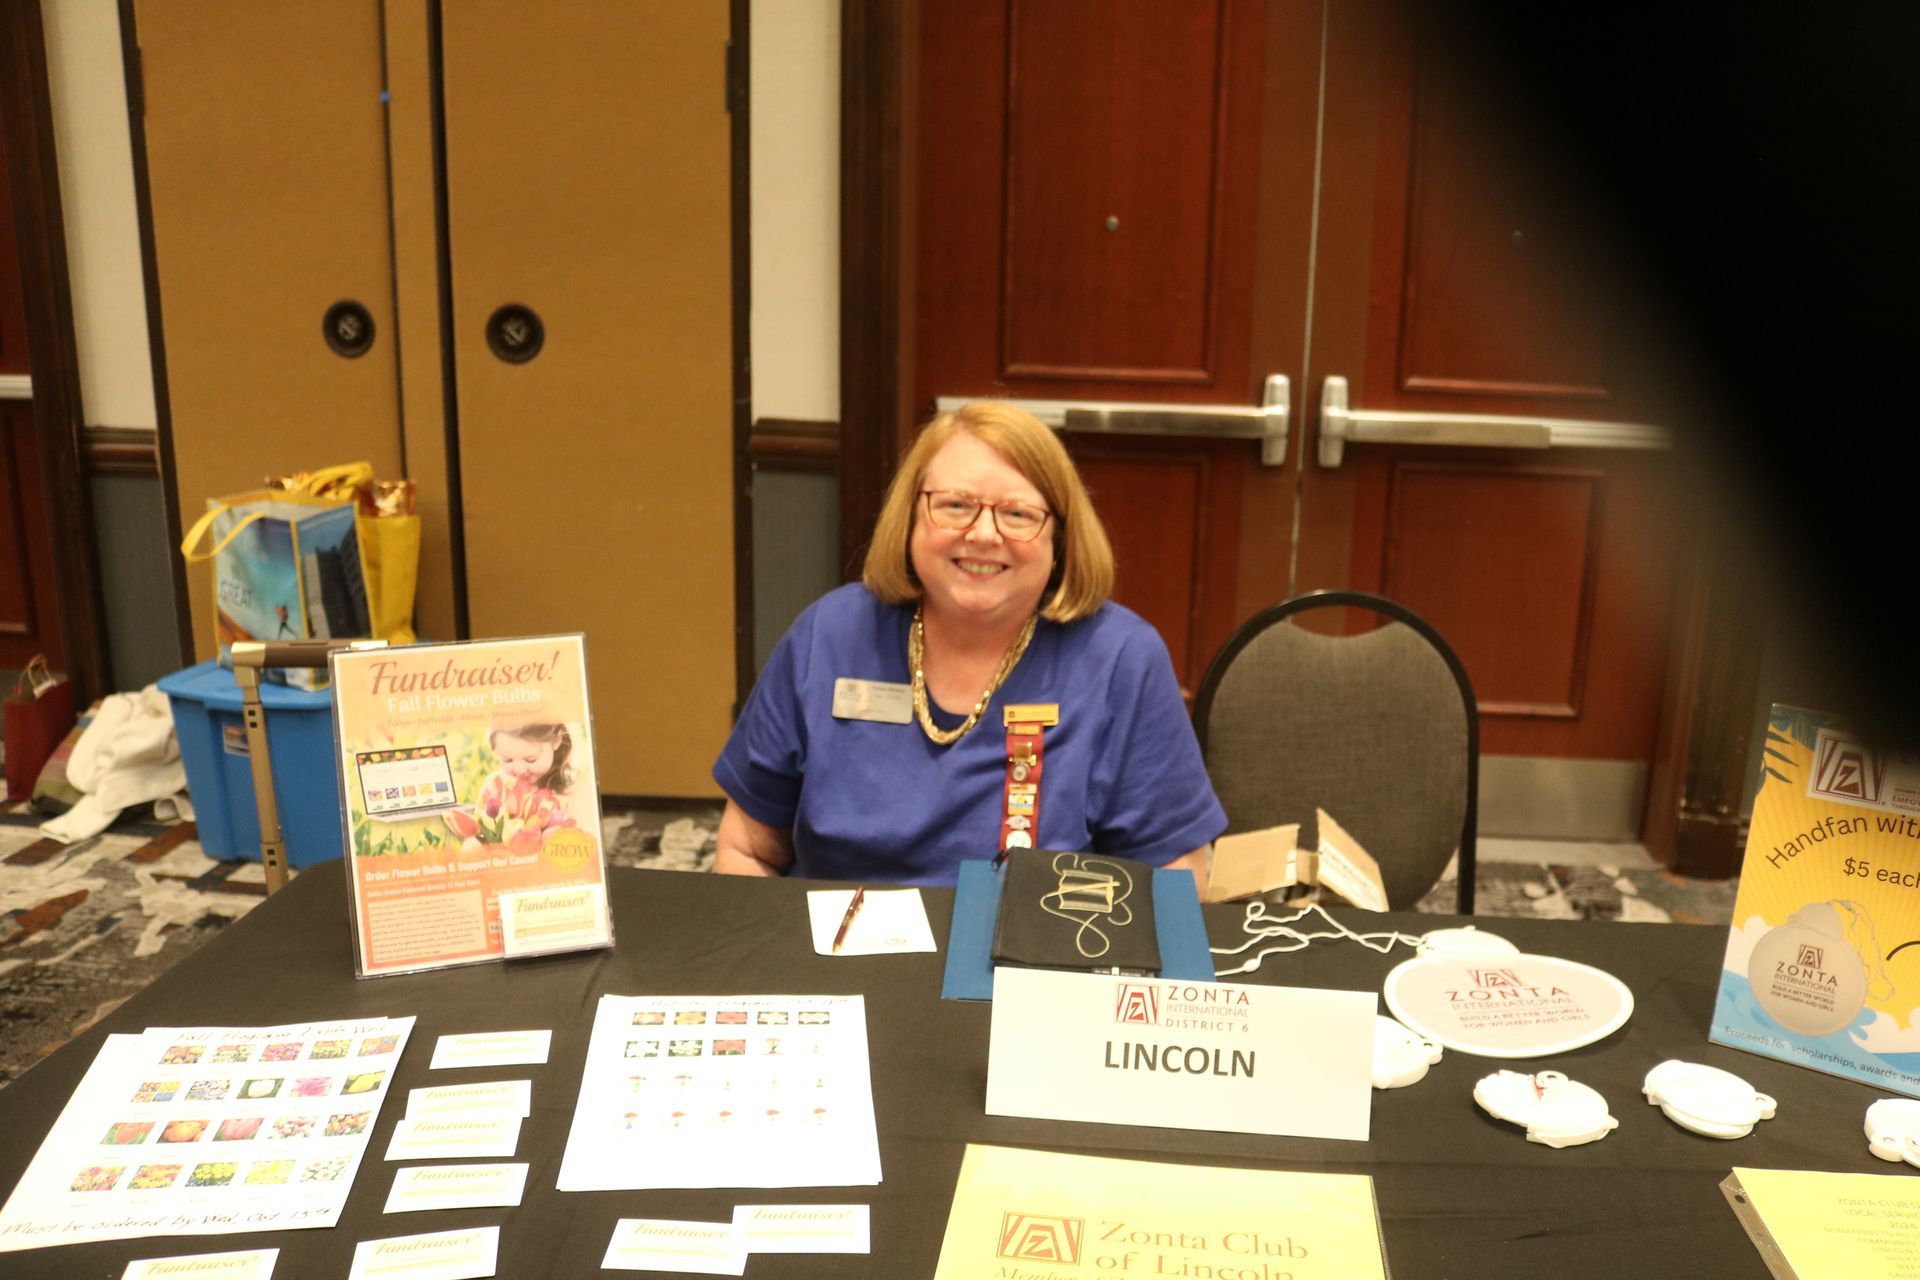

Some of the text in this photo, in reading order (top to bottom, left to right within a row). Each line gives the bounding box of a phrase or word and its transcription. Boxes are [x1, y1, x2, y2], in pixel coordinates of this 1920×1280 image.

[368, 650, 560, 696] Fundraiser!
[387, 686, 543, 714] Fall Flower Bulbs
[542, 843, 594, 859] GROW
[1765, 815, 1920, 869] Handfan wit
[365, 871, 389, 882] Order
[392, 868, 420, 879] Flower
[422, 865, 446, 876] Bulbs
[457, 858, 492, 873] Support
[1843, 857, 1920, 889] $5 eac
[516, 892, 591, 913] Fundraiser!
[1774, 973, 1836, 994] INTERNATIONAL
[1776, 961, 1838, 987] ZONTA
[1168, 985, 1249, 1005] ZONTA
[1444, 986, 1569, 1002] ZONTA
[1166, 1003, 1248, 1018] INTERNATIONAL
[1166, 1018, 1249, 1033] DISTRICT 6
[1105, 1041, 1255, 1078] LINCOLN
[1725, 1026, 1769, 1047] Proceeds
[1791, 1045, 1857, 1071] scholarships,
[1859, 1063, 1897, 1080] awards
[1099, 1220, 1309, 1260] Zonta Club
[1095, 1251, 1294, 1280] of Lincoln
